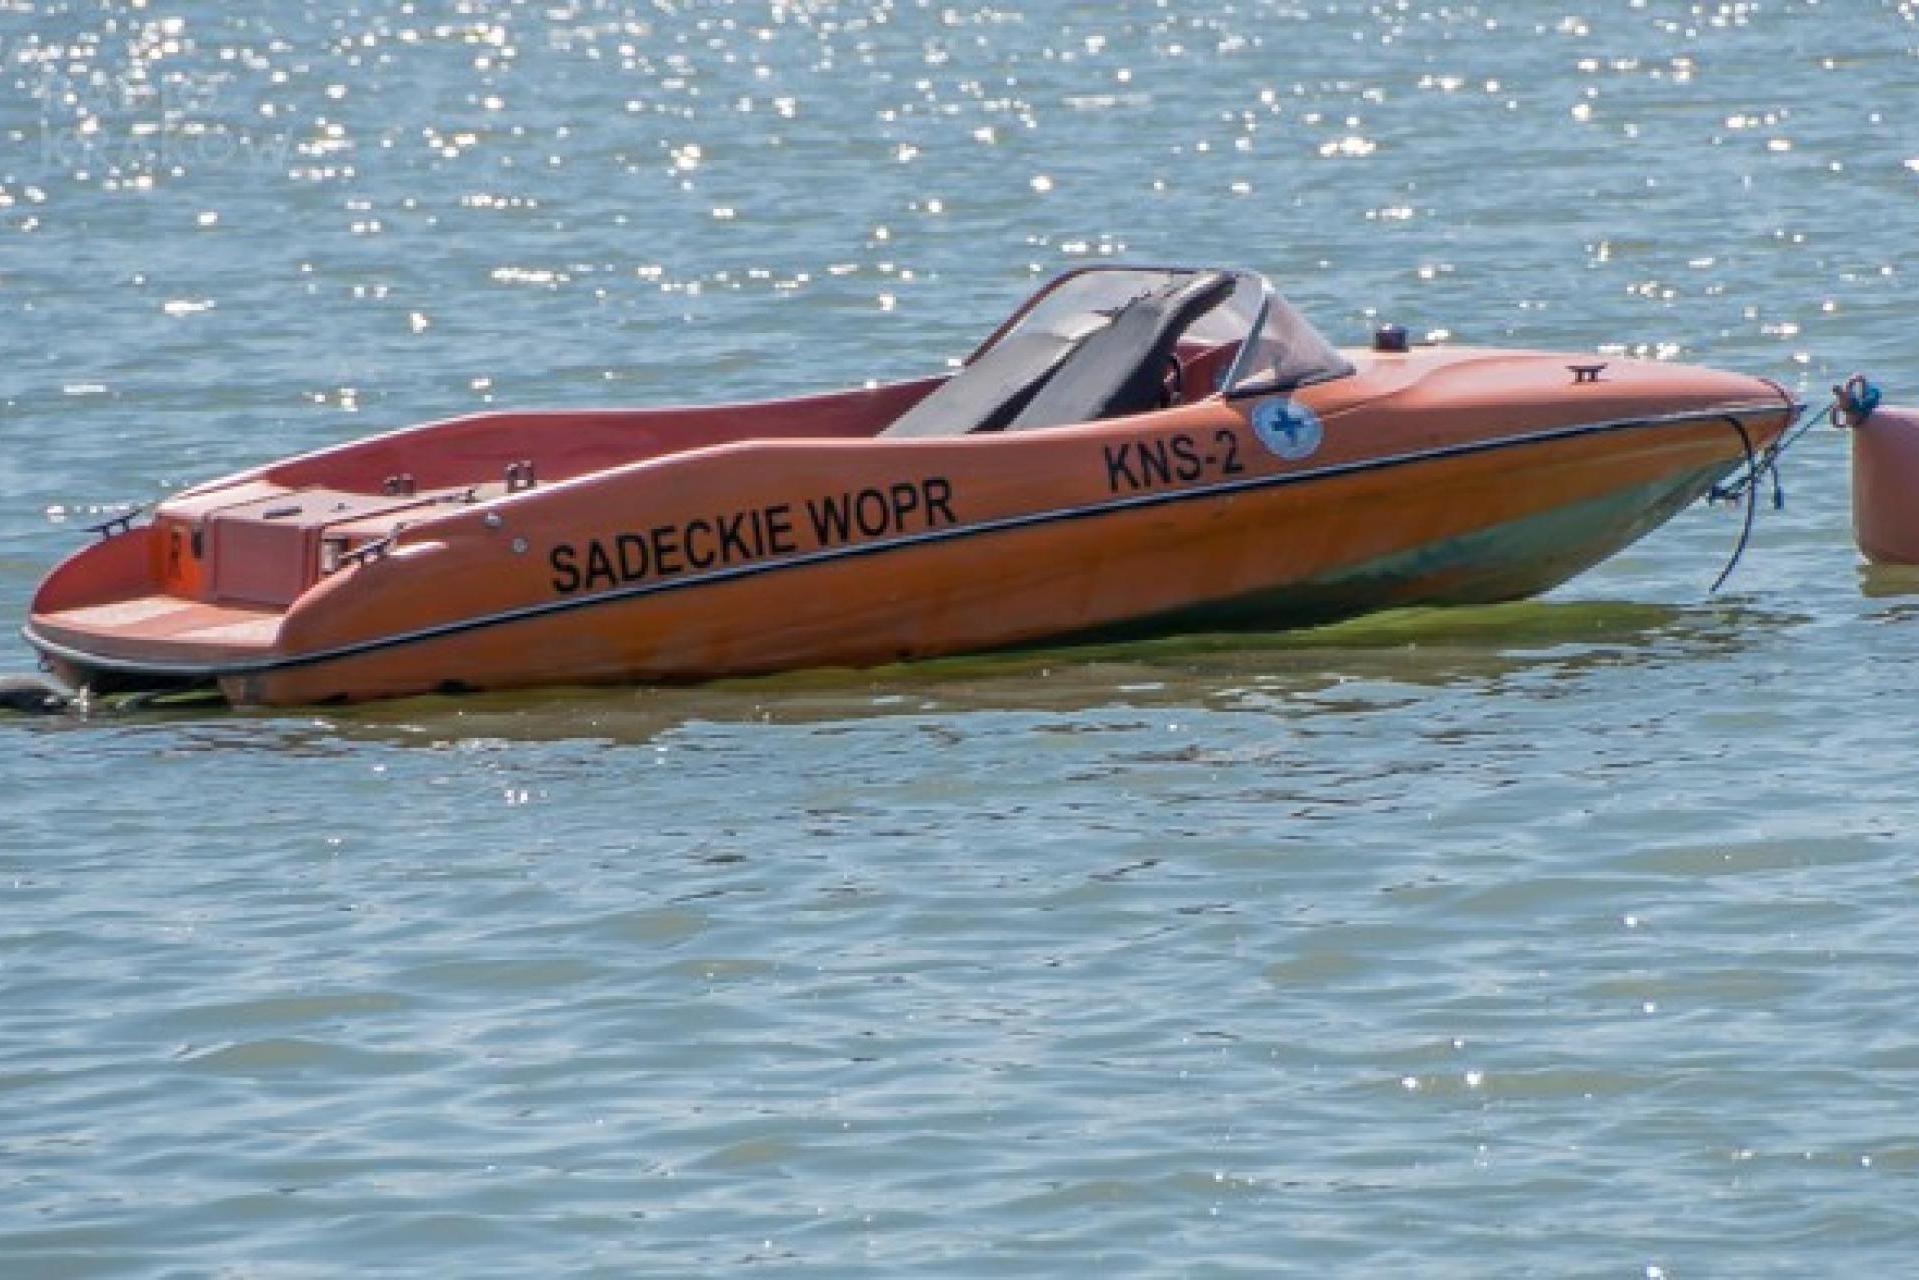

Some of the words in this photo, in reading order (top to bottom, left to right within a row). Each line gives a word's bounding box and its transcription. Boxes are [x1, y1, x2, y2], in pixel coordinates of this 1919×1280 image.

[1104, 429, 1245, 494] KNS-2
[549, 503, 798, 594] SADECKIE
[806, 476, 958, 546] WOPR
